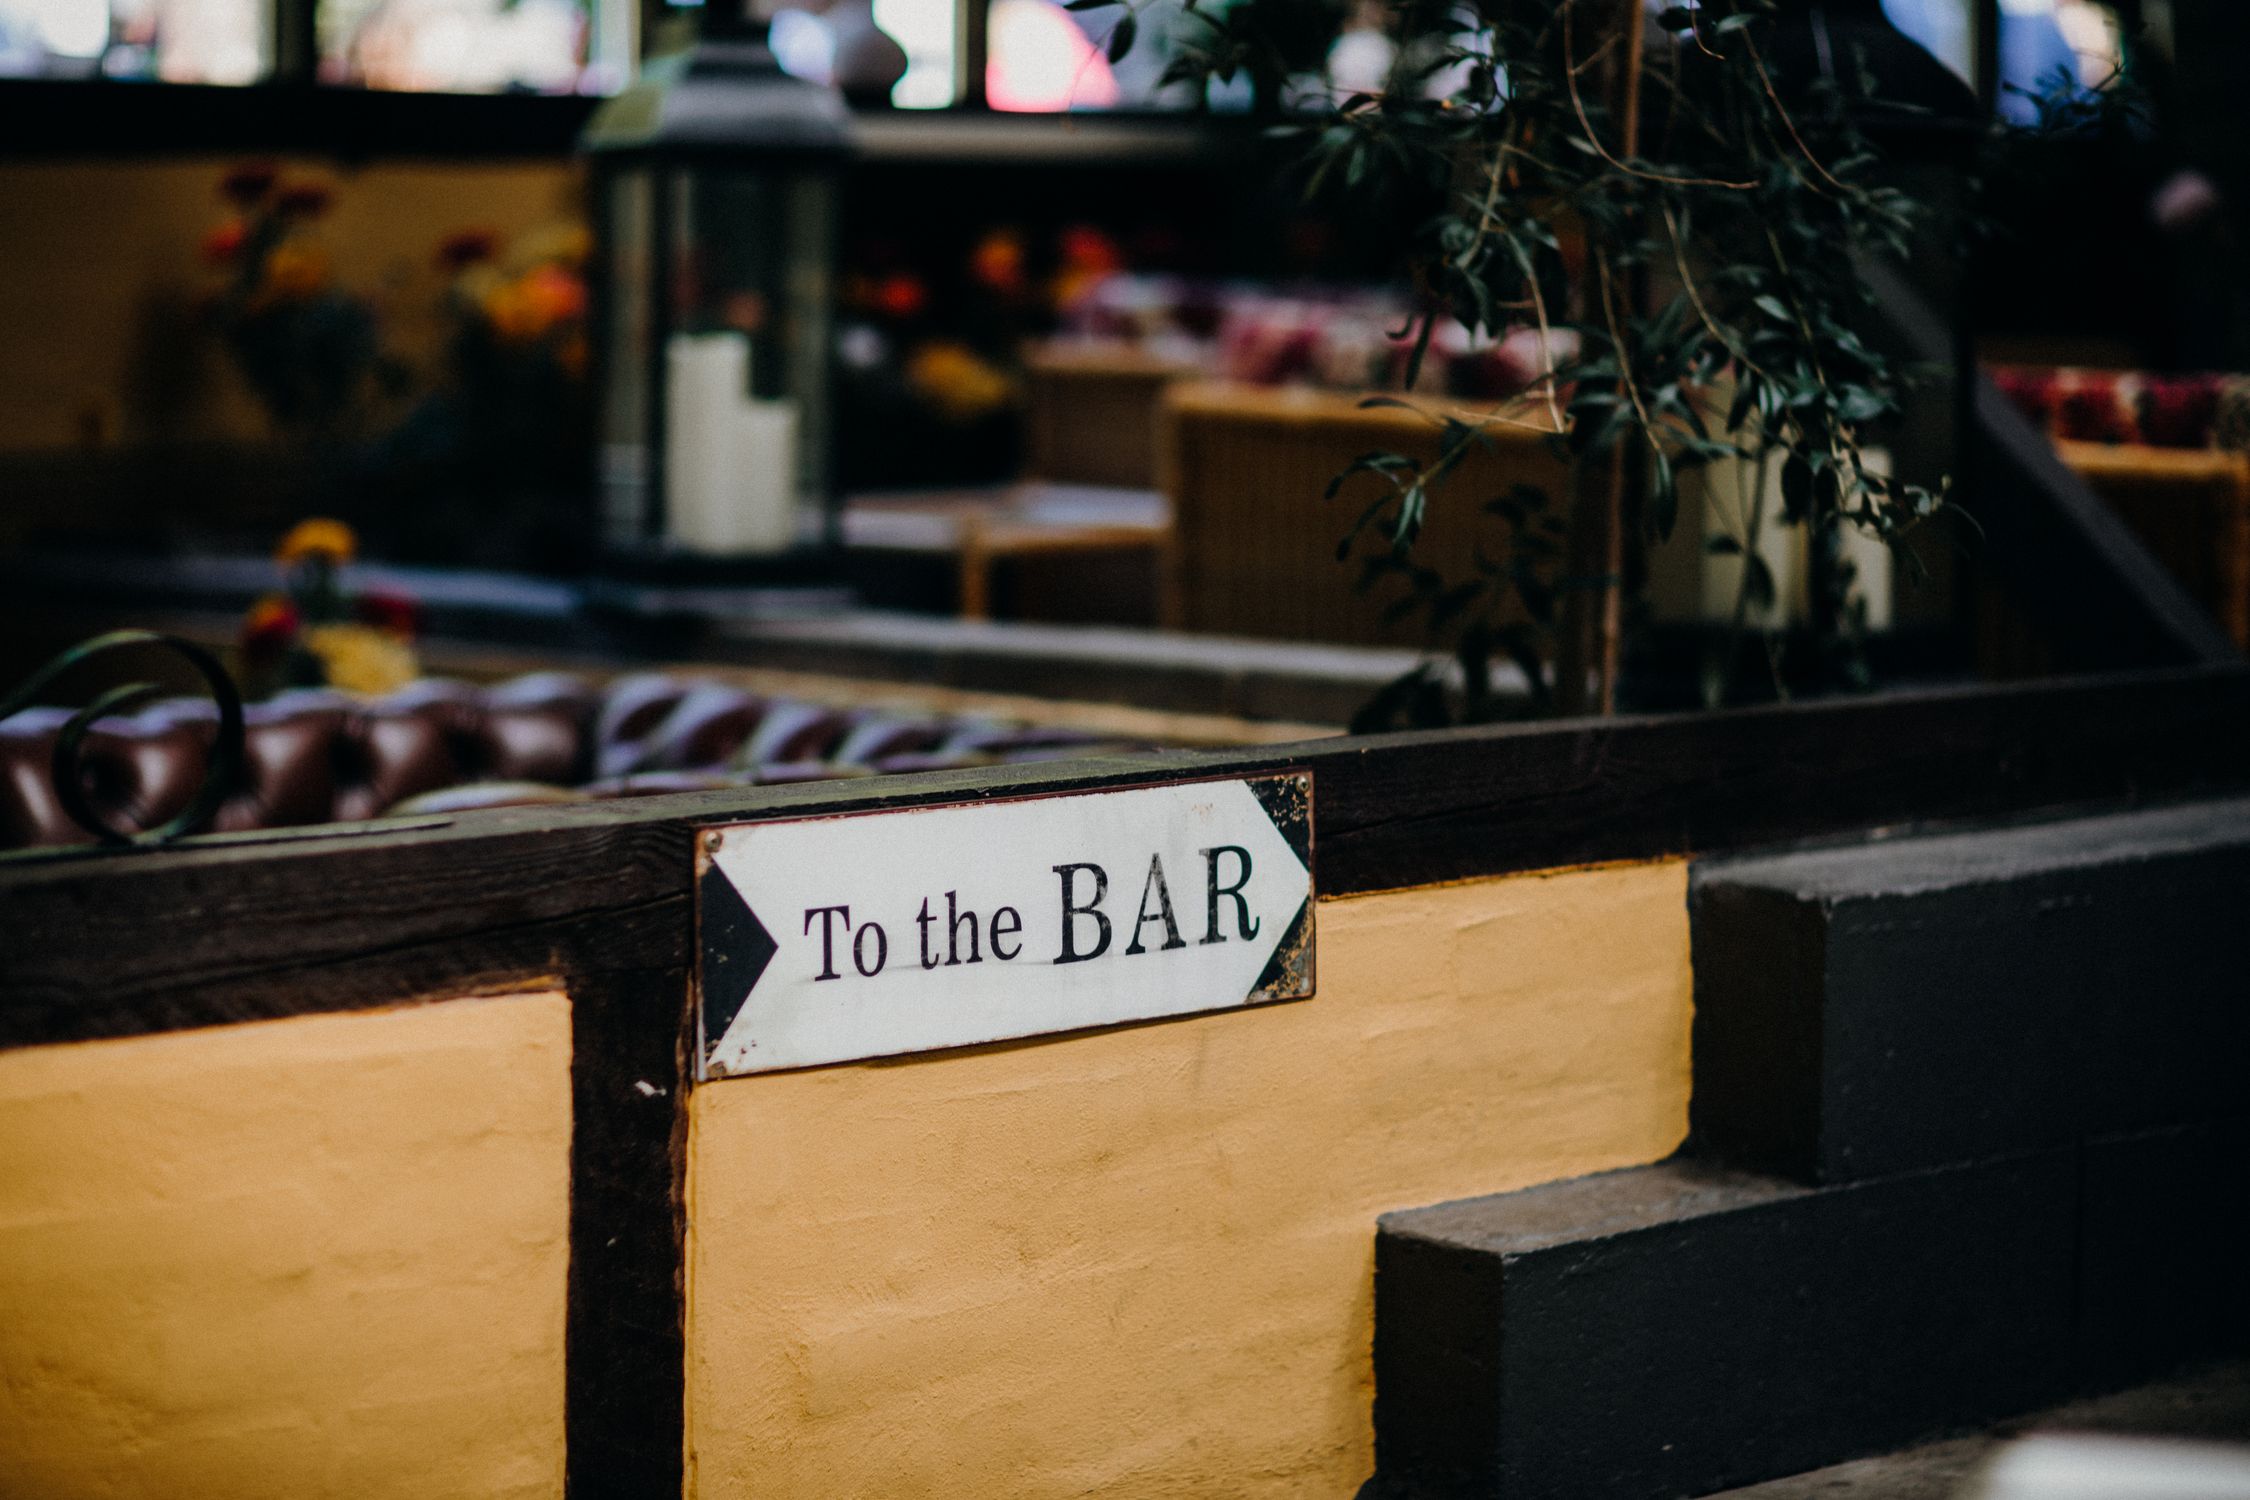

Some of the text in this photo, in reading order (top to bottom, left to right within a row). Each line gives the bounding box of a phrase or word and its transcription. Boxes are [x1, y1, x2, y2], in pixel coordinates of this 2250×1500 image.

[804, 845, 1261, 982] To the BAR
